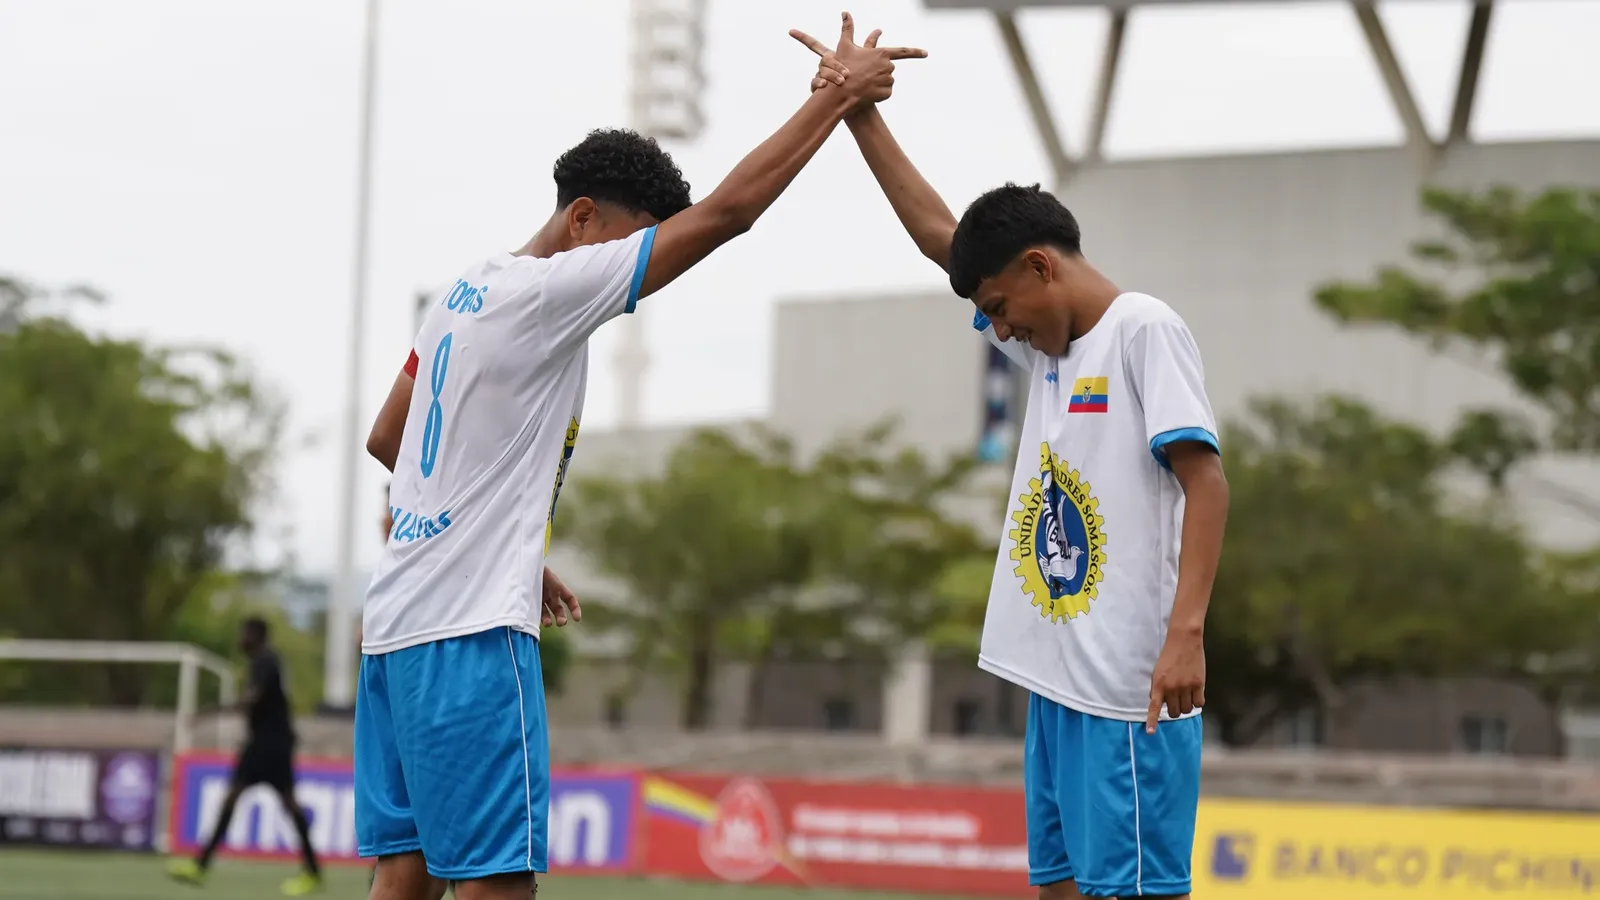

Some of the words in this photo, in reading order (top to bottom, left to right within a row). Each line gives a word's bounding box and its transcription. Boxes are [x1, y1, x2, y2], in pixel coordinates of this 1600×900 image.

[420, 331, 453, 479] 8
[1020, 492, 1042, 559] UNIDAD
[1082, 504, 1100, 595] SOMASCOS
[1273, 838, 1430, 886] BANCO
